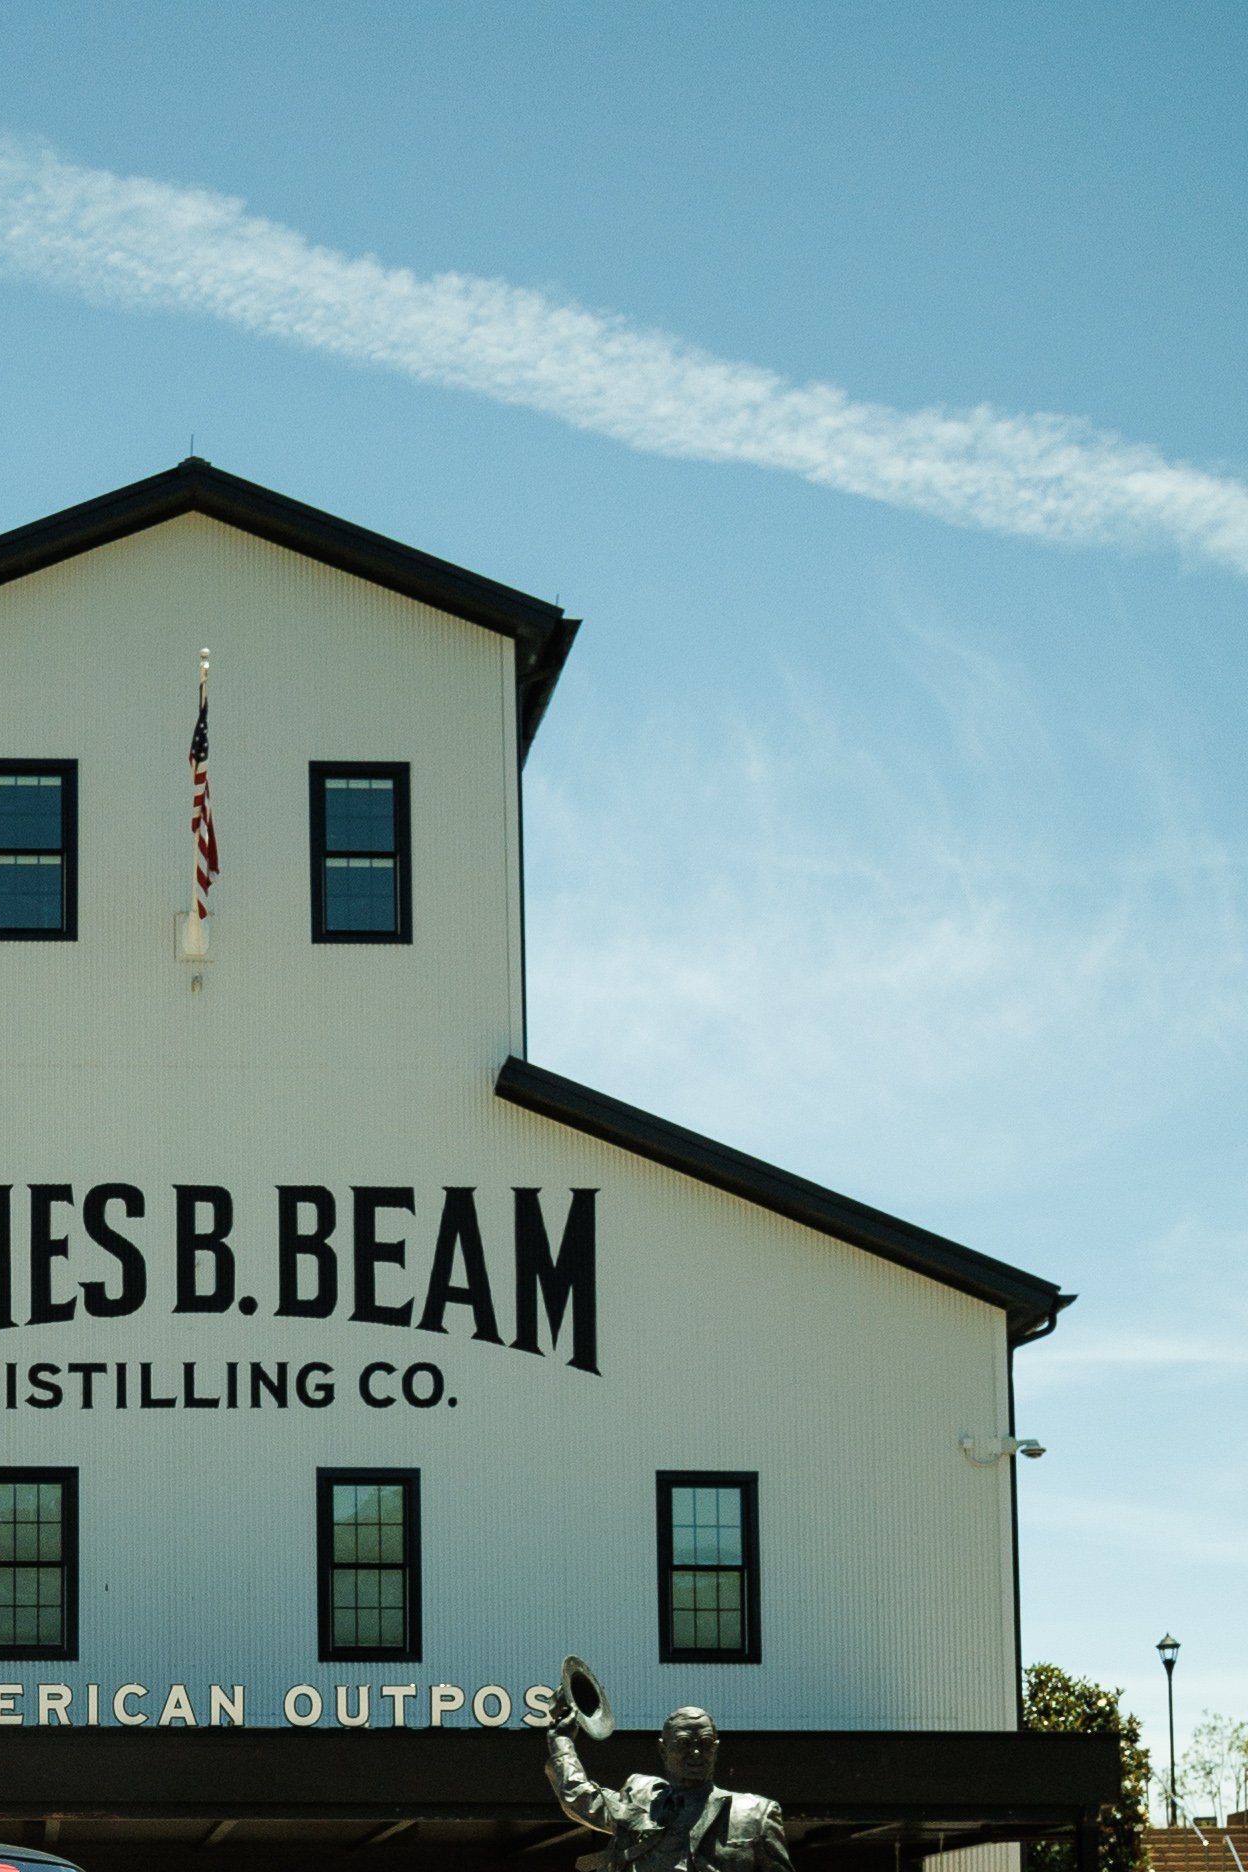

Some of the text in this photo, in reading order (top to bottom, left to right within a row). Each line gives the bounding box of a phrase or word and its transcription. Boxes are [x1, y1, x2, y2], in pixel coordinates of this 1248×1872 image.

[172, 1184, 258, 1316] B.
[274, 1184, 603, 1377] BEAM
[358, 1361, 459, 1410] CO.
[283, 1683, 556, 1727] OUTPOS
